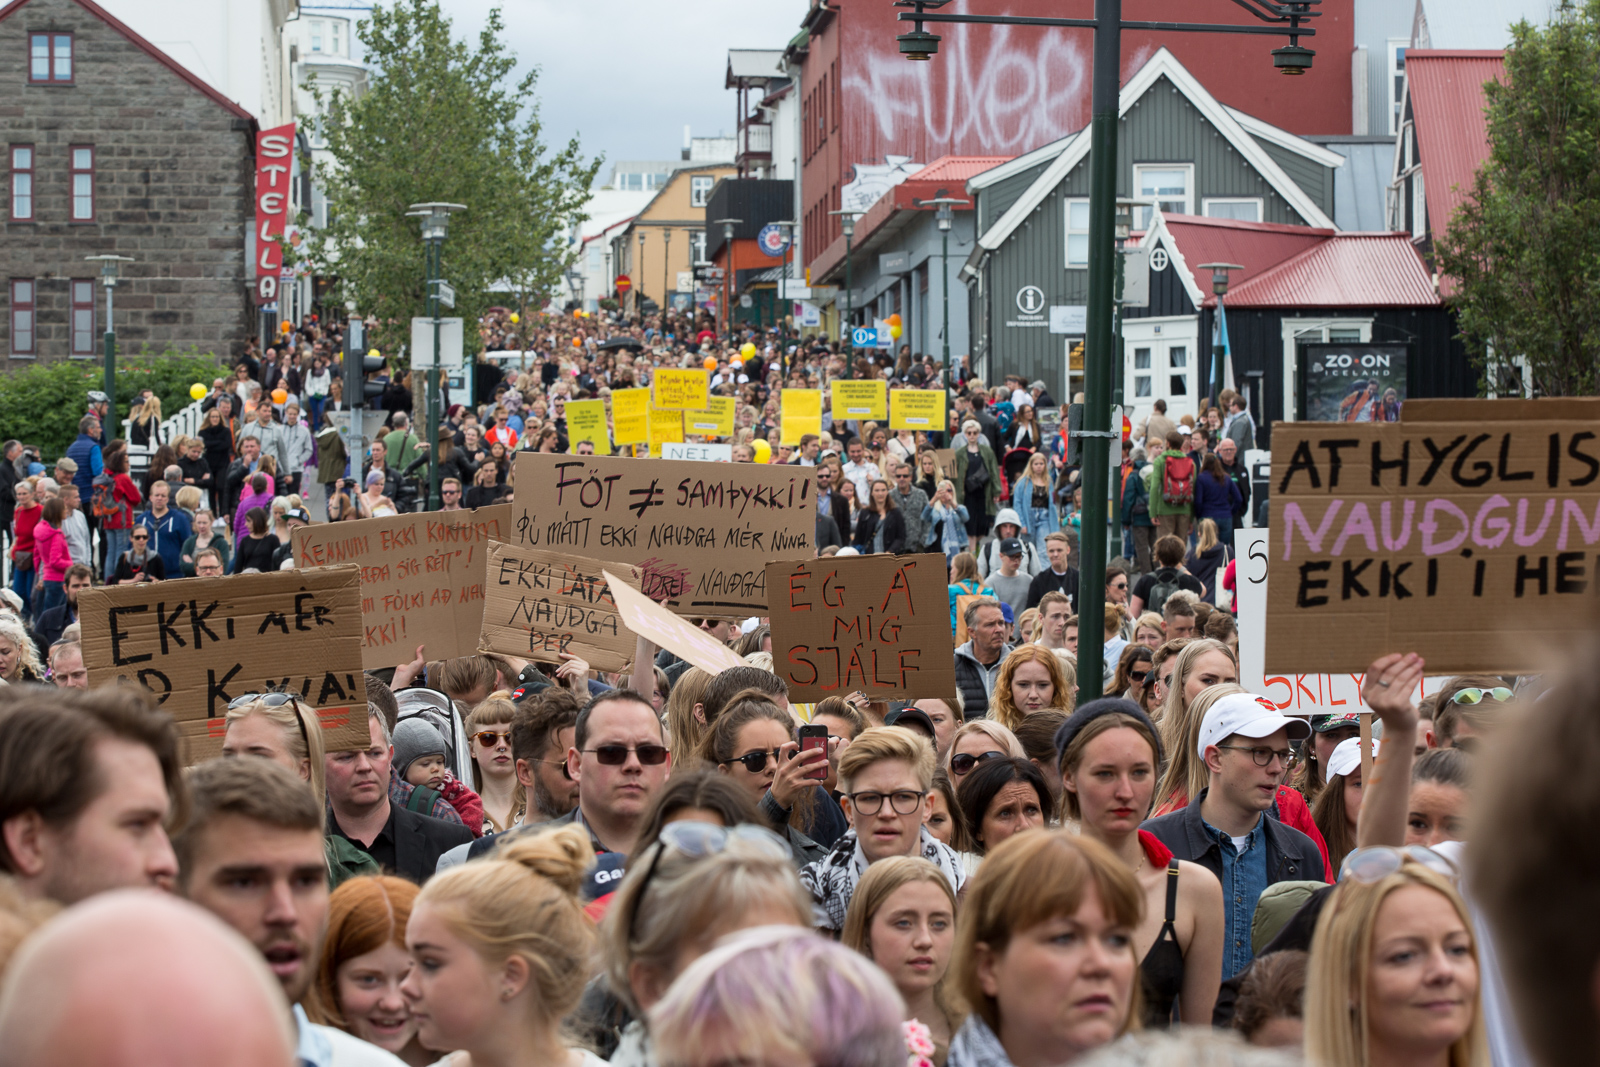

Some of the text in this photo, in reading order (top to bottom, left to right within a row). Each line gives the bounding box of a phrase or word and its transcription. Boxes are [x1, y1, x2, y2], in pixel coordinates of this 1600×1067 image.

[259, 134, 290, 299] STELLA
[670, 447, 709, 460] NEI
[1278, 431, 1600, 494] ATHYGLIS
[555, 461, 624, 512] FÖT
[299, 534, 370, 568] KENNUM
[426, 519, 502, 543] KONUM
[547, 511, 592, 548] MÁTT
[647, 523, 716, 550] NAUÐGA
[724, 522, 765, 552] MÉR
[361, 563, 390, 585] ÆÐA
[430, 588, 452, 607] AÐ
[695, 568, 766, 598] NAUÐGA
[789, 561, 917, 616] ÉG Á
[1296, 558, 1438, 609] EKKI
[1514, 551, 1600, 598] HE
[257, 586, 335, 636] MÉR
[508, 596, 618, 636] NAUÐGA
[787, 642, 921, 691] SJÁLF
